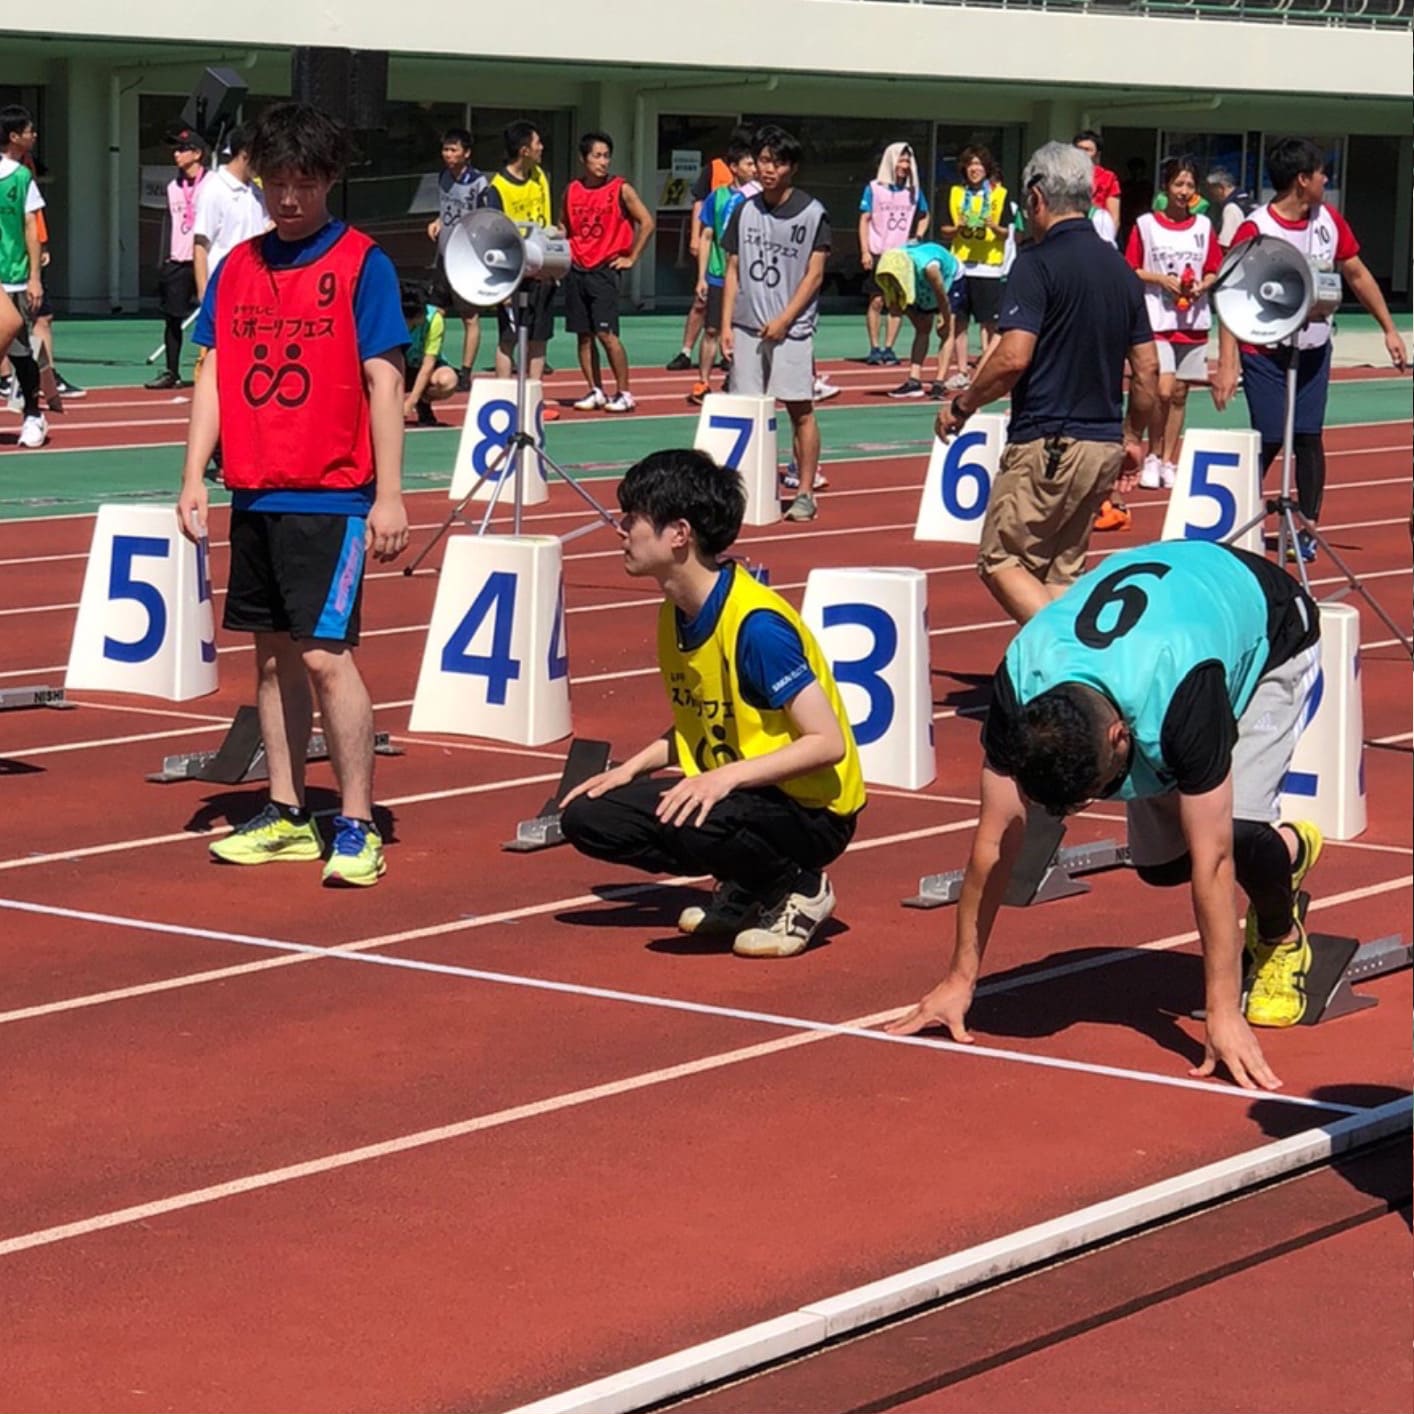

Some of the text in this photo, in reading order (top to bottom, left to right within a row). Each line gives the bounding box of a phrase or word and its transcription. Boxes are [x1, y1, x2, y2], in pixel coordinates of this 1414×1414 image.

[791, 224, 807, 245] 10
[317, 271, 336, 308] 9
[472, 399, 519, 482] 8
[708, 415, 754, 471] 7
[940, 431, 990, 521] 6
[1183, 451, 1241, 542] 5
[103, 535, 171, 664] 5
[441, 571, 521, 706] 4
[1073, 561, 1173, 650] 6
[820, 602, 898, 747] 3
